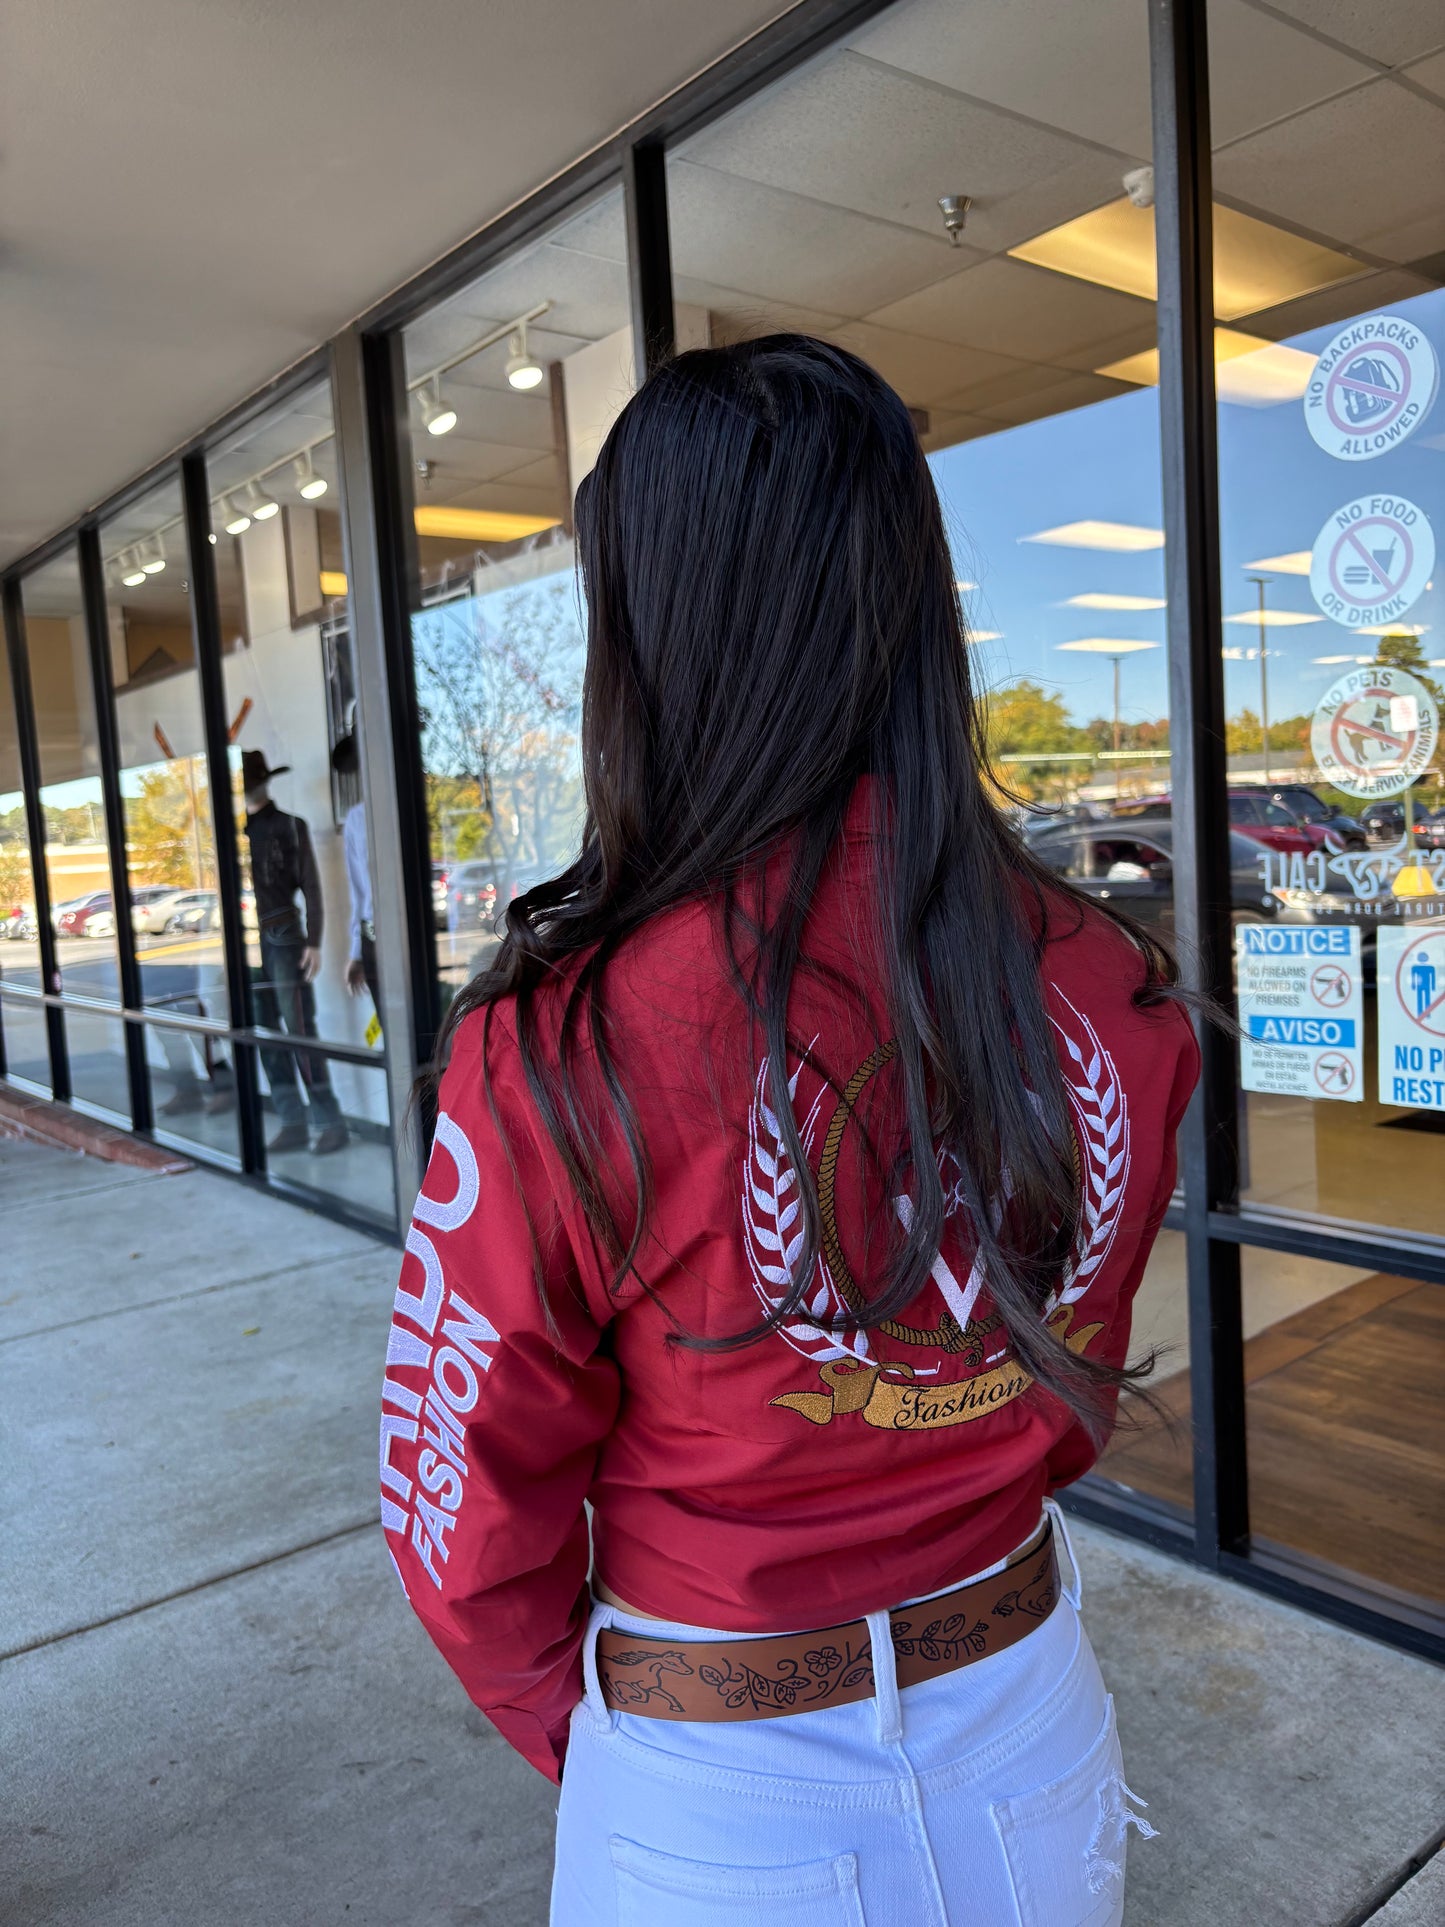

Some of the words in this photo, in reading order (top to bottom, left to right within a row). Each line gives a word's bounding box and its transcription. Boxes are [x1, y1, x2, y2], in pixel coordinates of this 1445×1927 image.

[1309, 381, 1324, 408] NO
[1319, 321, 1419, 373] BACKPACKS
[1340, 402, 1420, 455] ALLOWED
[1336, 504, 1363, 529] NO
[1370, 498, 1418, 527] FOOD
[1322, 592, 1345, 618] OR
[1348, 597, 1408, 624] DRINK
[1321, 690, 1344, 716] NO
[1347, 671, 1394, 692] PETS
[1411, 709, 1431, 769] ANIMALS
[1250, 930, 1346, 953] NOTICE
[1248, 966, 1260, 977] NO
[1262, 966, 1306, 977] FIREARMS
[1249, 979, 1291, 992] ALLOWED
[1292, 979, 1306, 992] ON
[1256, 993, 1300, 1007] PREMISES
[1262, 1019, 1342, 1045] AVISO
[1395, 1045, 1423, 1071] NO
[1430, 1047, 1445, 1073] P
[1393, 1076, 1445, 1106] REST
[893, 1376, 1027, 1430] Fashion
[411, 1289, 501, 1591] FASHION
